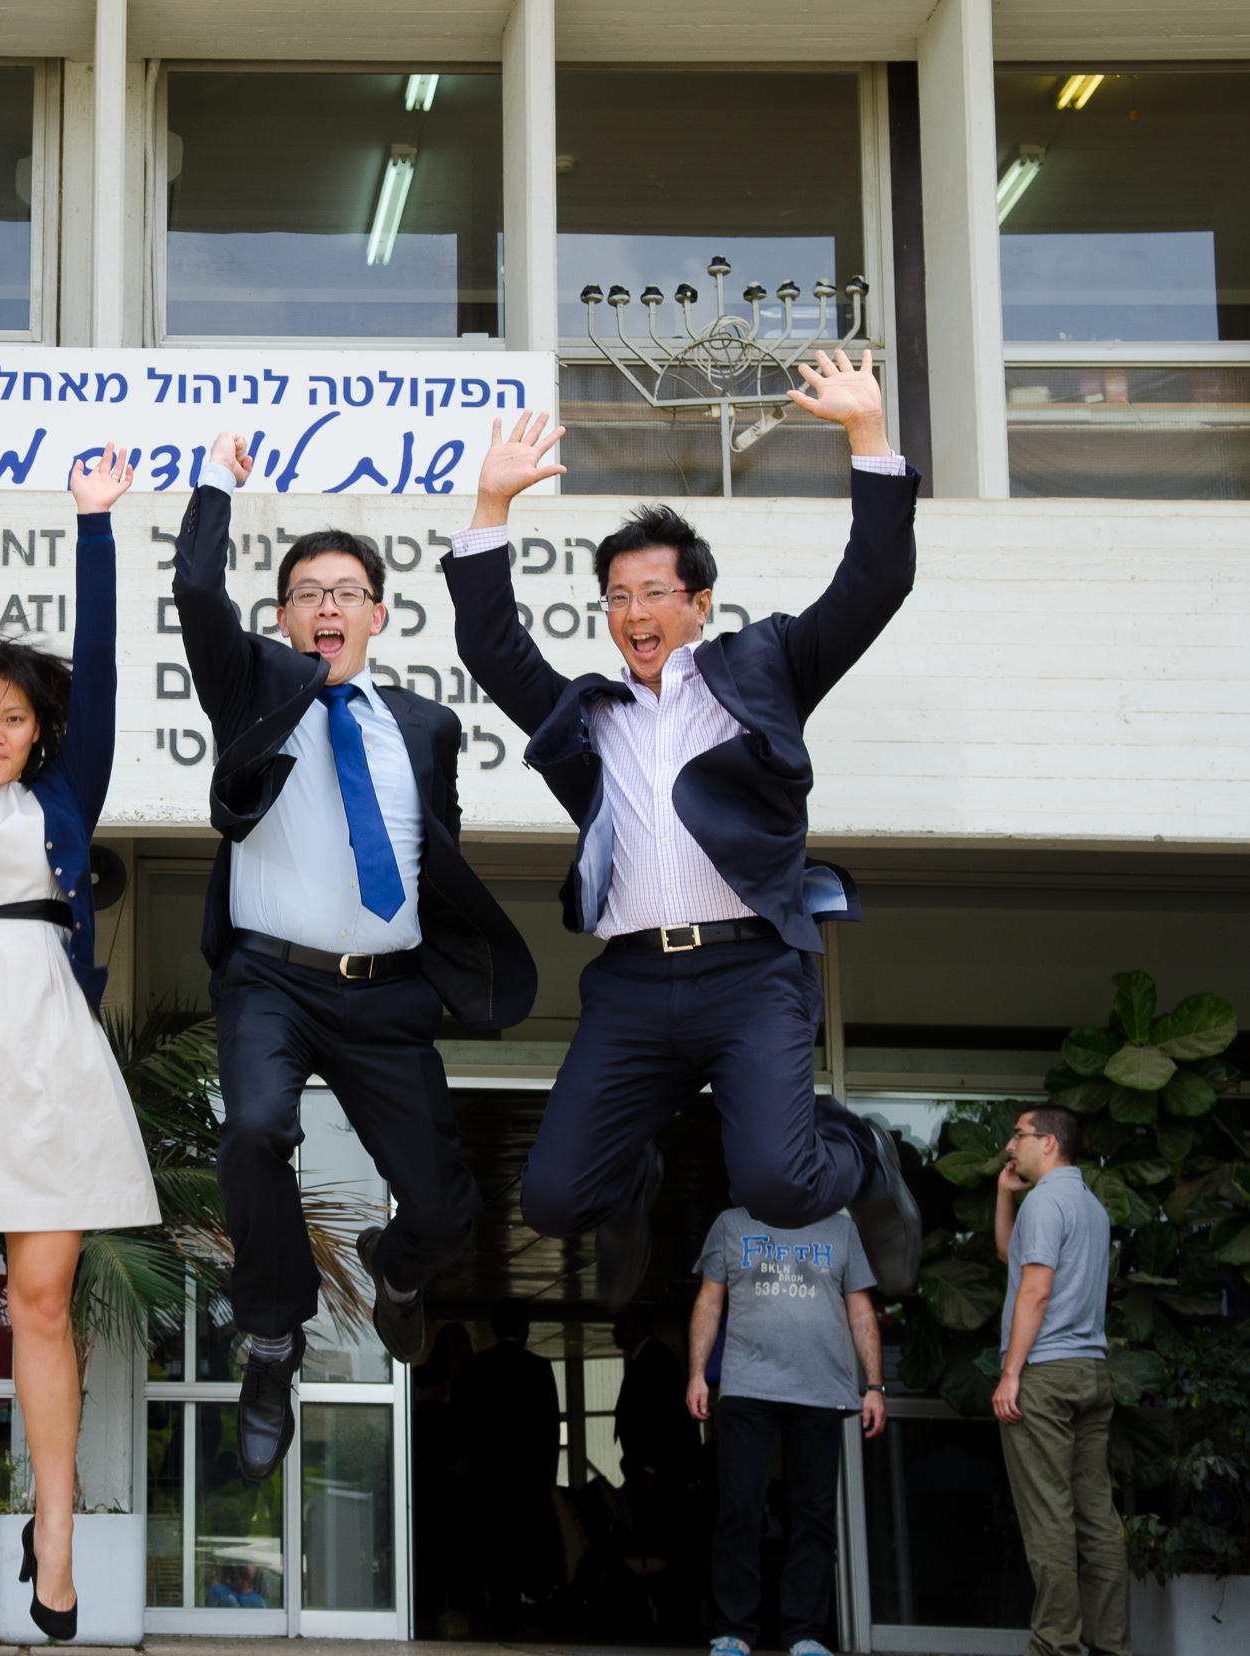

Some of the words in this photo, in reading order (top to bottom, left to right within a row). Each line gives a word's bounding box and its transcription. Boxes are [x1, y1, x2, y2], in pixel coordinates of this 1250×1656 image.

[147, 367, 289, 405] לניהול
[308, 370, 526, 417] הפקולטה
[321, 430, 465, 494] שנת
[741, 1235, 833, 1269] FIFTH
[761, 1262, 791, 1274] BKLN
[755, 1281, 817, 1299] 538-004
